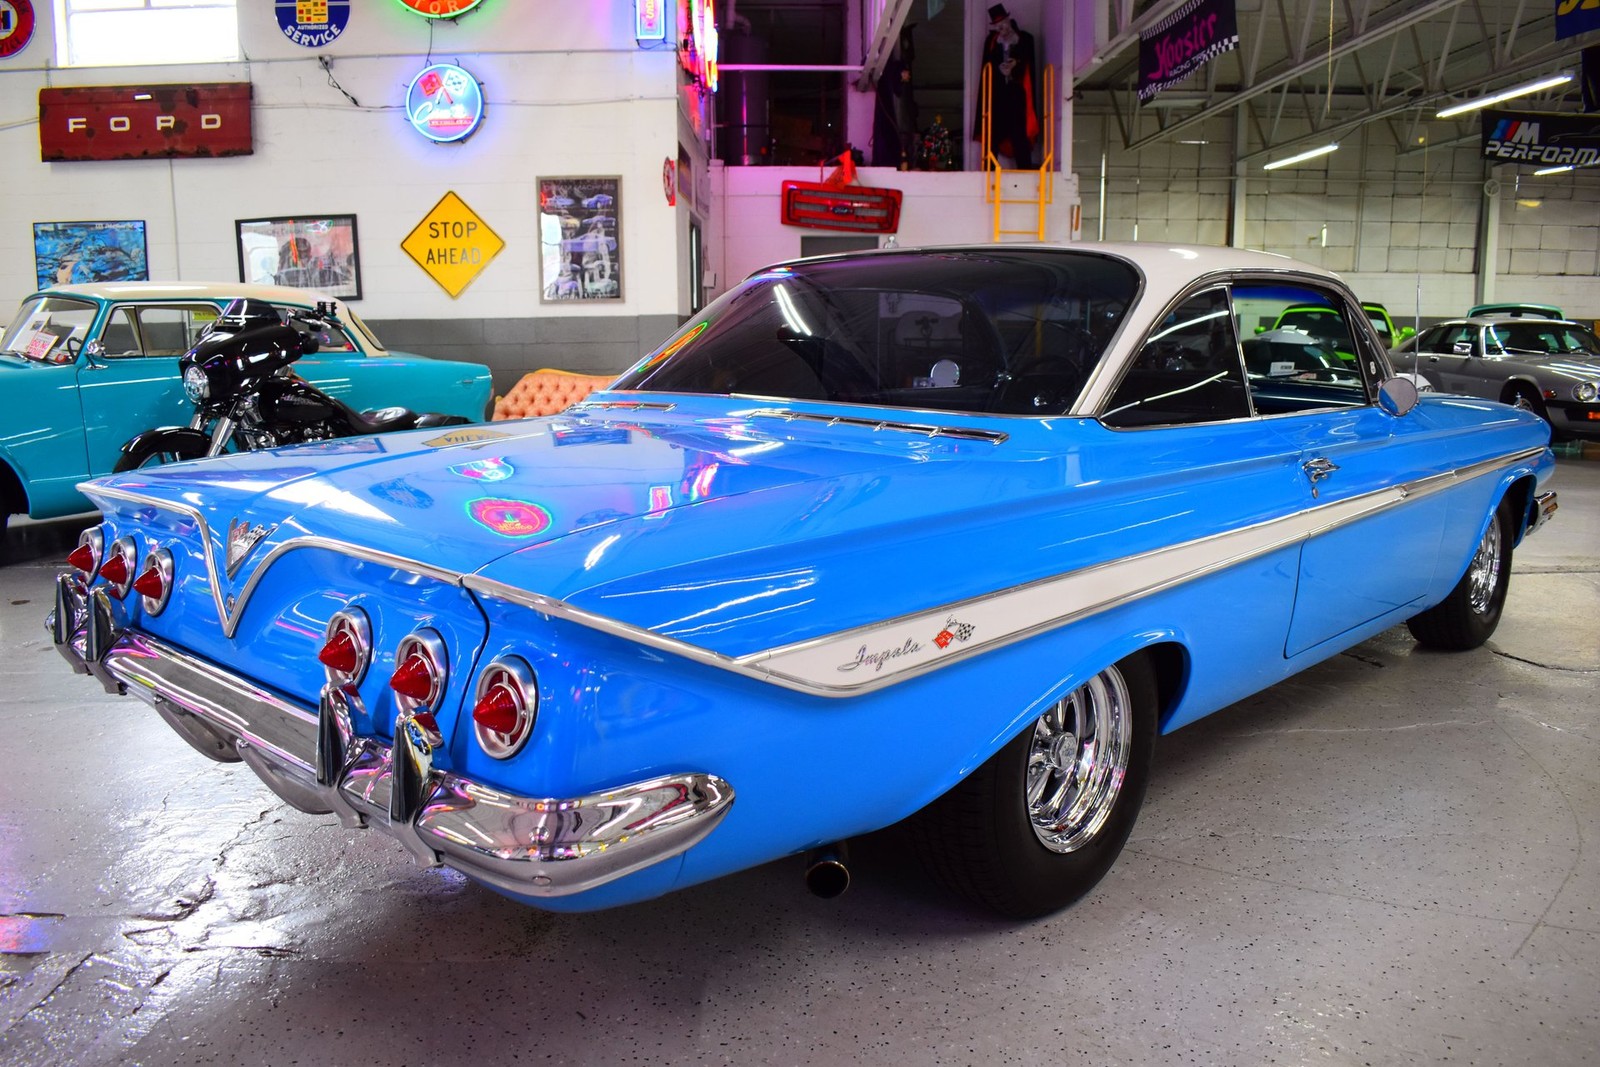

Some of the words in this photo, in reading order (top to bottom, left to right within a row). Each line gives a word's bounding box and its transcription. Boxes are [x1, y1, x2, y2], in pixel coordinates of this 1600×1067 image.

[284, 23, 341, 47] SERVICE
[1147, 13, 1217, 79] Hoosier
[68, 114, 222, 133] FORD
[1511, 121, 1540, 145] M
[428, 221, 478, 239] STOP
[426, 248, 482, 264] AHEAD
[837, 637, 925, 672] Impala
